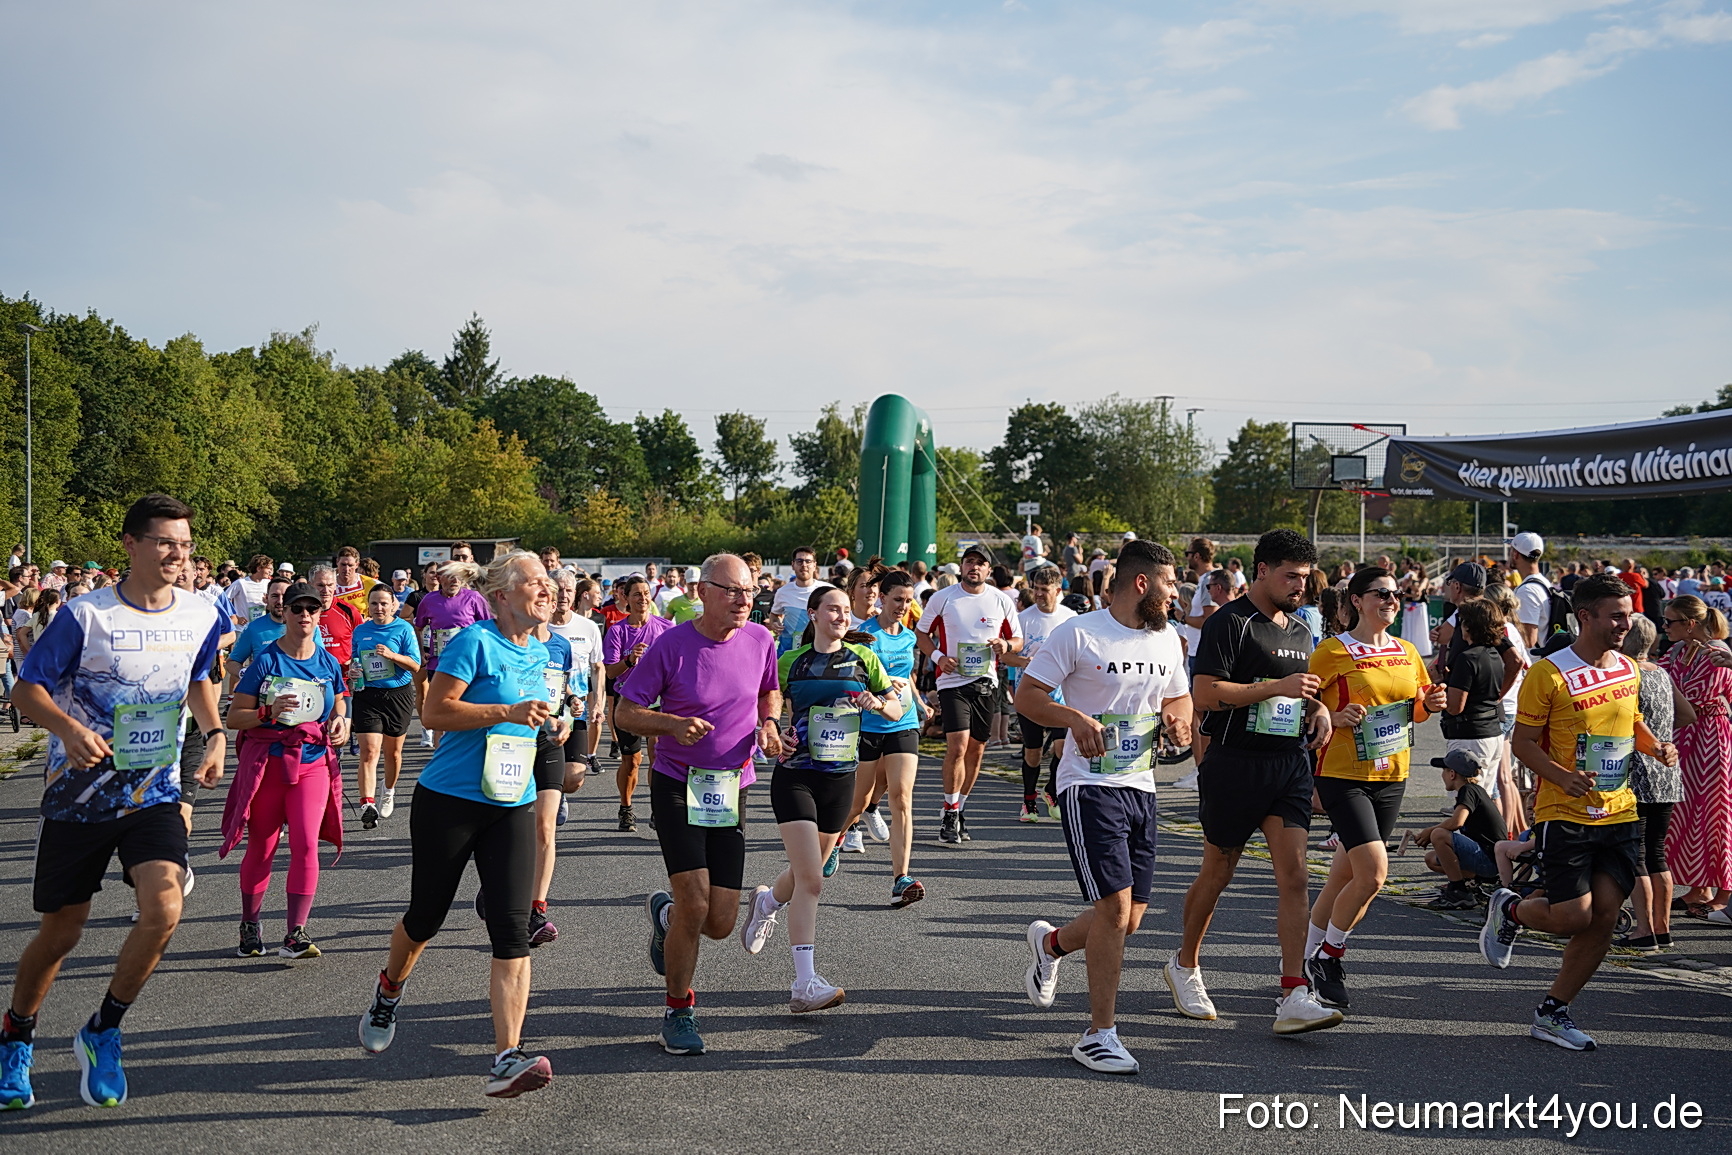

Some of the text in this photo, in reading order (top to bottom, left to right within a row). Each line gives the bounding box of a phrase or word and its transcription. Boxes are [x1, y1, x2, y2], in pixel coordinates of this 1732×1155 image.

[1458, 459, 1499, 487] Hier
[1499, 455, 1582, 496] gewinnt
[1584, 454, 1626, 485] das
[146, 630, 194, 641] PETTER
[1277, 649, 1306, 660] APTIV
[1106, 662, 1166, 676] APTIV
[1355, 657, 1412, 669] MAX BÖGL
[1276, 703, 1292, 715] 96
[1573, 693, 1609, 712] MAX
[128, 729, 164, 745] 2021
[820, 729, 845, 741] 434
[1373, 723, 1401, 738] 1688
[1121, 739, 1139, 751] 83
[500, 763, 522, 777] 1211
[1600, 758, 1624, 771] 1817
[702, 792, 725, 806] 691
